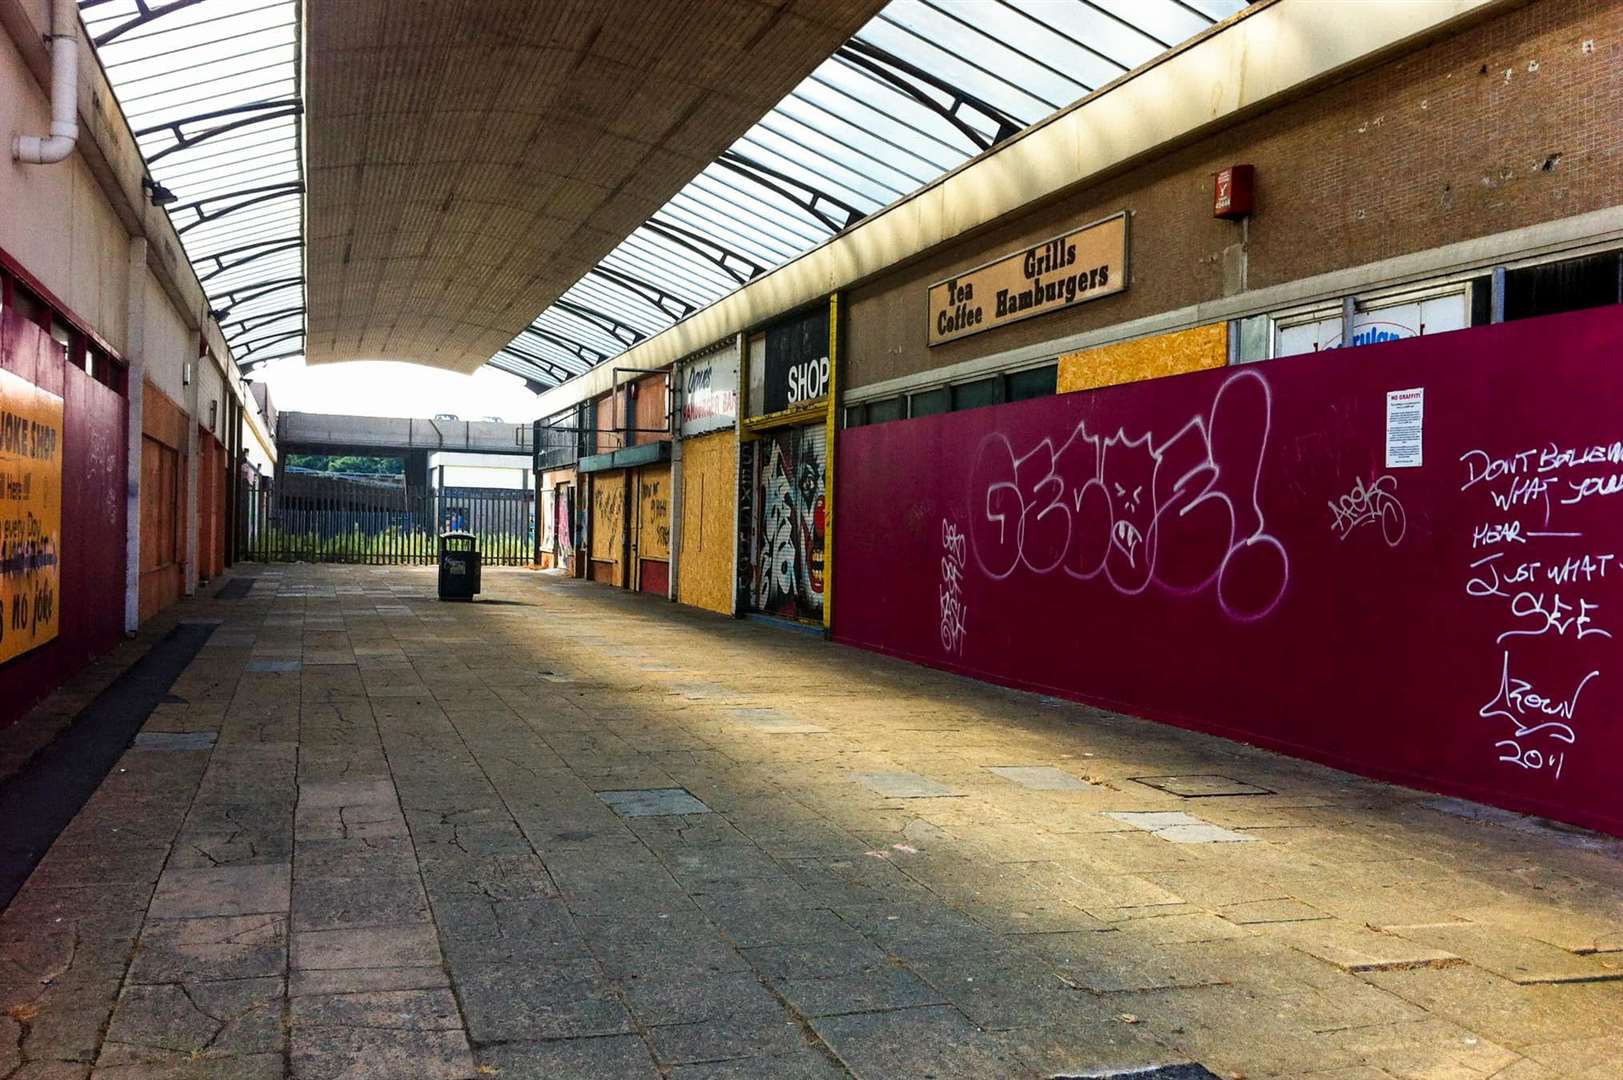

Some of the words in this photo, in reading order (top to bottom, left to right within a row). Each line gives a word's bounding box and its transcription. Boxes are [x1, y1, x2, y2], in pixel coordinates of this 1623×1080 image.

[1024, 238, 1076, 280] Grills
[948, 279, 973, 306] Tea
[995, 264, 1109, 318] Hamburgers
[937, 304, 983, 336] Coffee
[787, 356, 830, 403] SHOP
[1399, 392, 1421, 401] GRAFFITI
[31, 421, 55, 462] SHOP
[1490, 474, 1558, 528] WHAT
[1547, 554, 1614, 585] WHAT
[12, 592, 28, 632] no
[32, 576, 53, 640] joke
